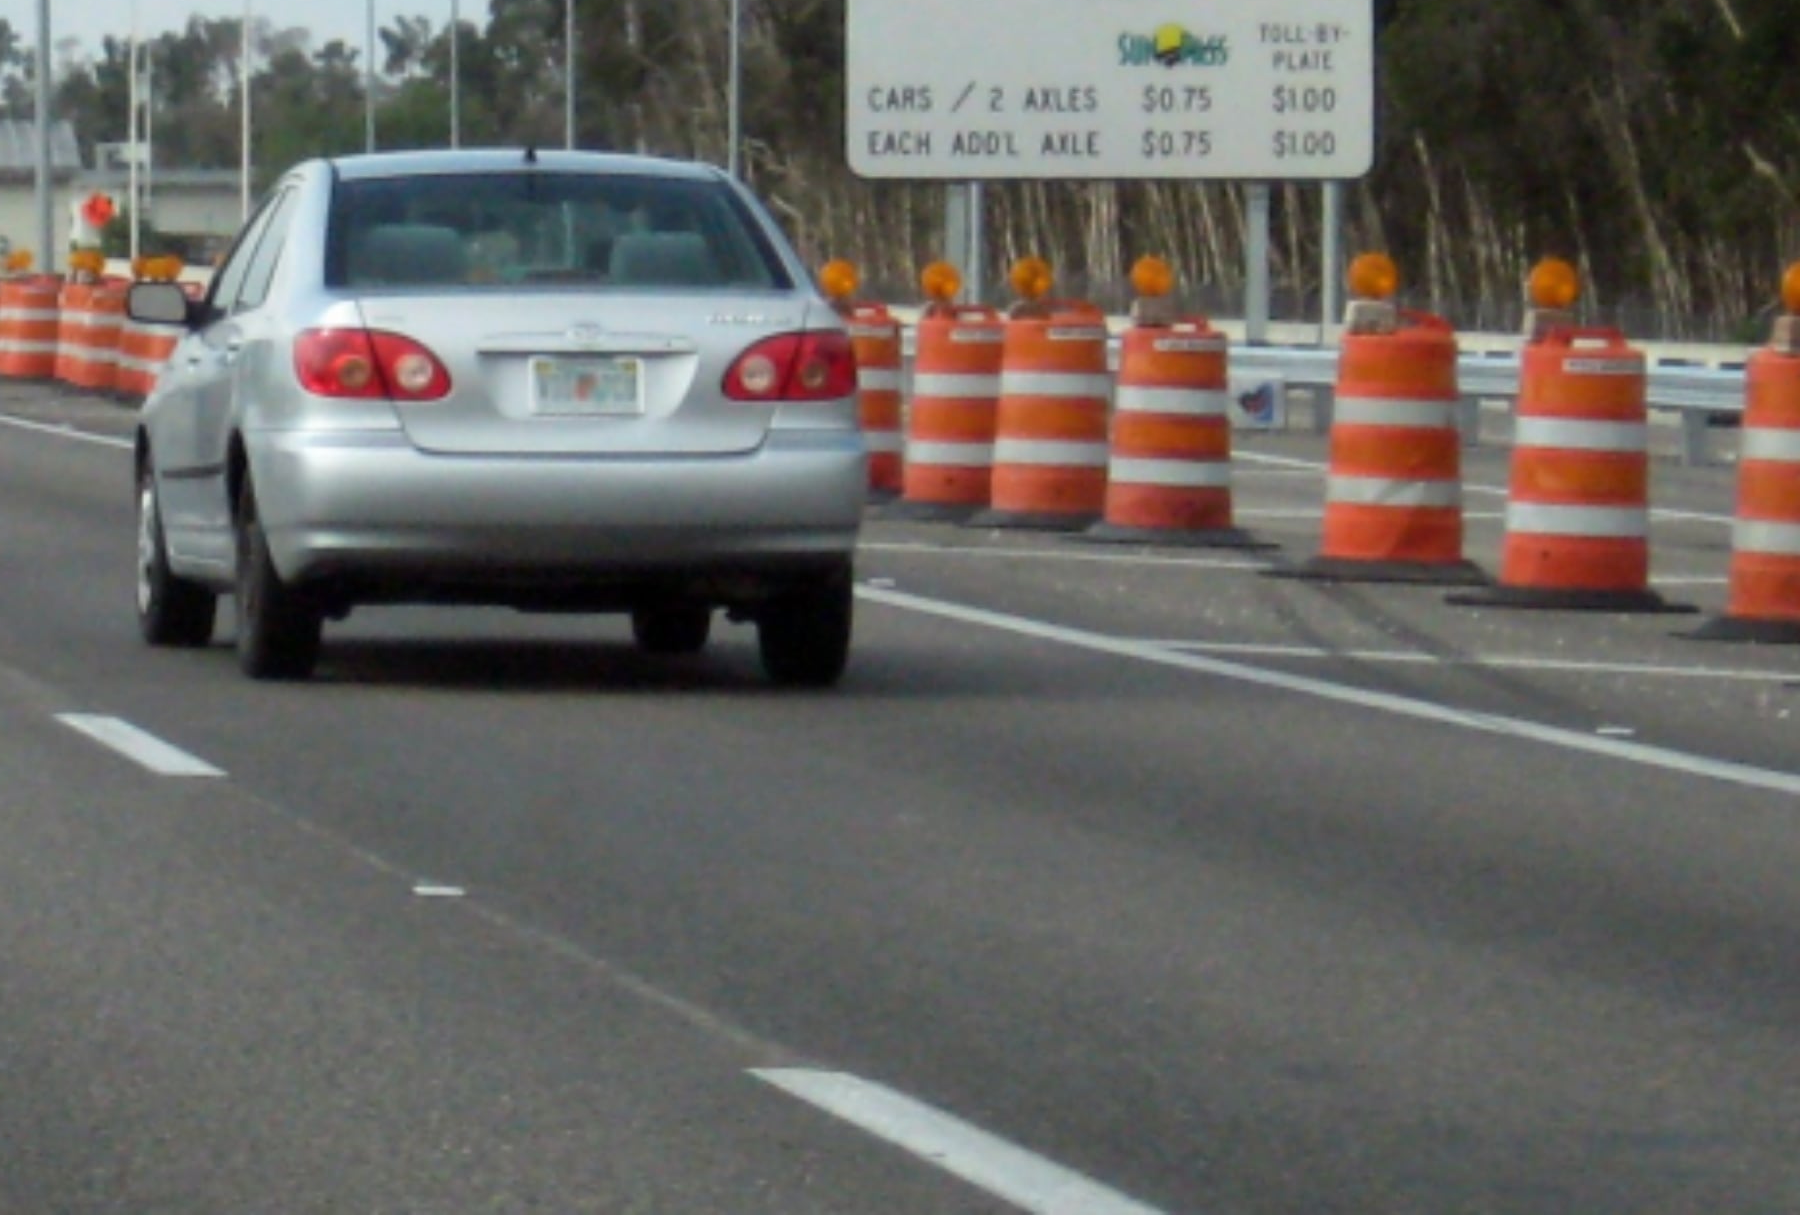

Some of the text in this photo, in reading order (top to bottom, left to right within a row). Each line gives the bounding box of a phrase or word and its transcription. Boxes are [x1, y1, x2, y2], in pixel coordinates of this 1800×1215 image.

[1272, 50, 1333, 70] PLATE
[867, 87, 931, 112] CARS
[952, 81, 976, 112] /
[989, 87, 1004, 112] 2
[1023, 87, 1097, 112] AXLES
[1142, 85, 1212, 113] $0.75
[867, 131, 931, 156] EACH
[1041, 131, 1101, 156] AXLE
[1142, 130, 1212, 158] $0.75
